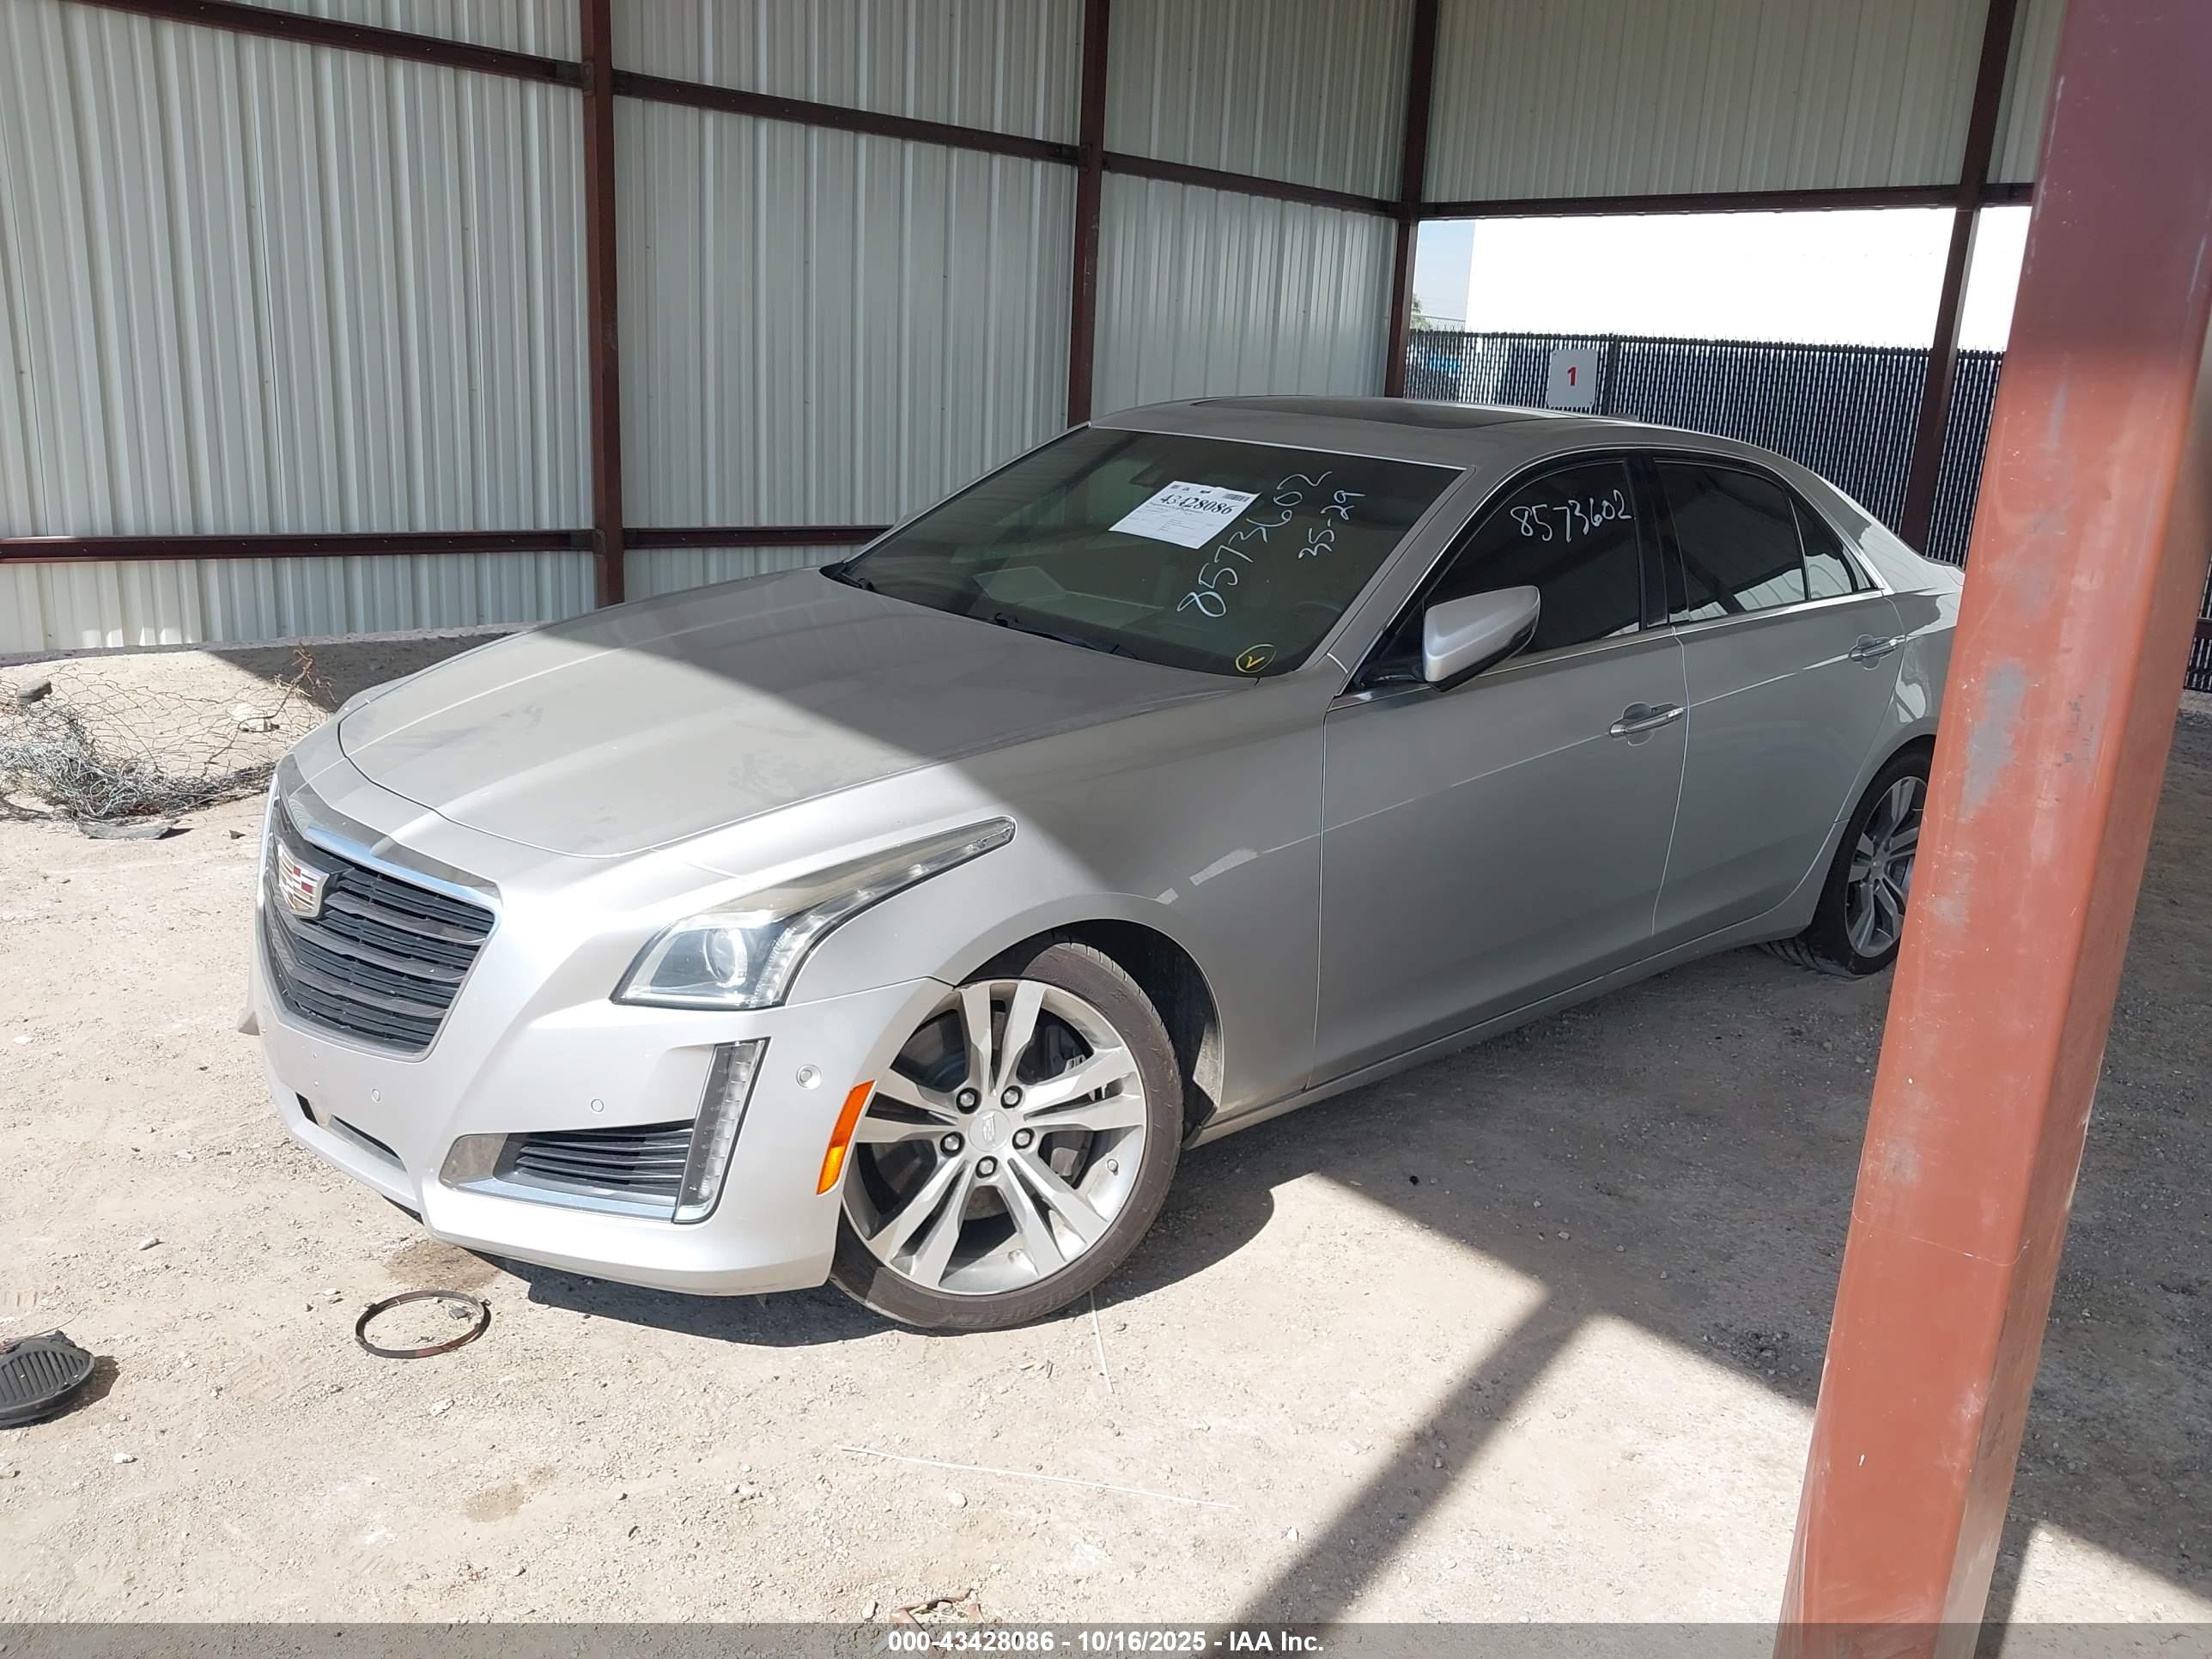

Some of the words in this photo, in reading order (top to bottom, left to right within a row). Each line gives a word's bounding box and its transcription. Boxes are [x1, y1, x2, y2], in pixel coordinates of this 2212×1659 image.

[1567, 366, 1577, 386] 1
[1160, 494, 1237, 515] 43428086
[1297, 489, 1367, 559] 35-29
[1510, 489, 1633, 543] 8573602
[1176, 471, 1333, 617] 8573602
